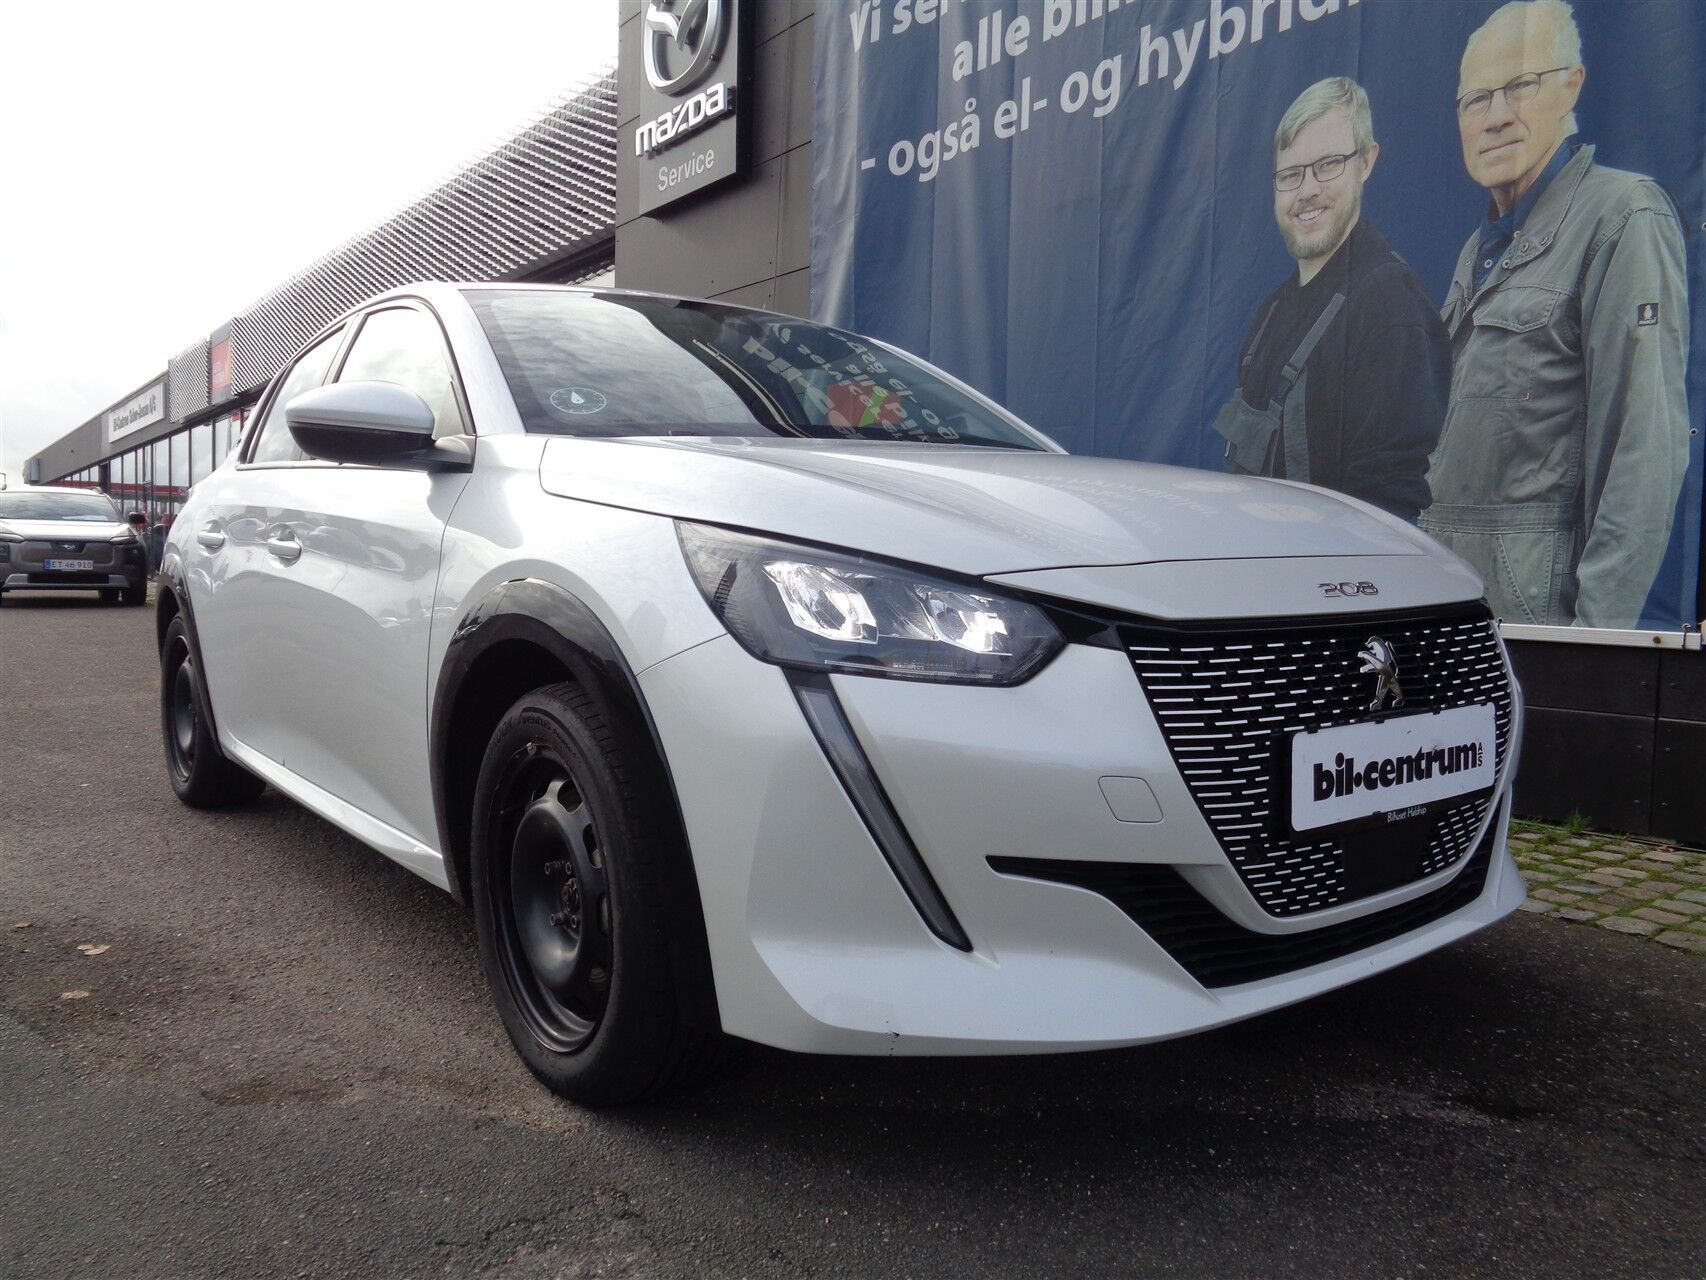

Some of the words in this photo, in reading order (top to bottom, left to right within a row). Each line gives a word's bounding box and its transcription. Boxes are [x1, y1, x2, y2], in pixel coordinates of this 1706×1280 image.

[952, 9, 1030, 82] alle
[887, 97, 981, 183] også
[993, 76, 1048, 139] el-
[1060, 54, 1122, 118] og
[657, 149, 715, 192] Service
[1318, 581, 1379, 598] 208
